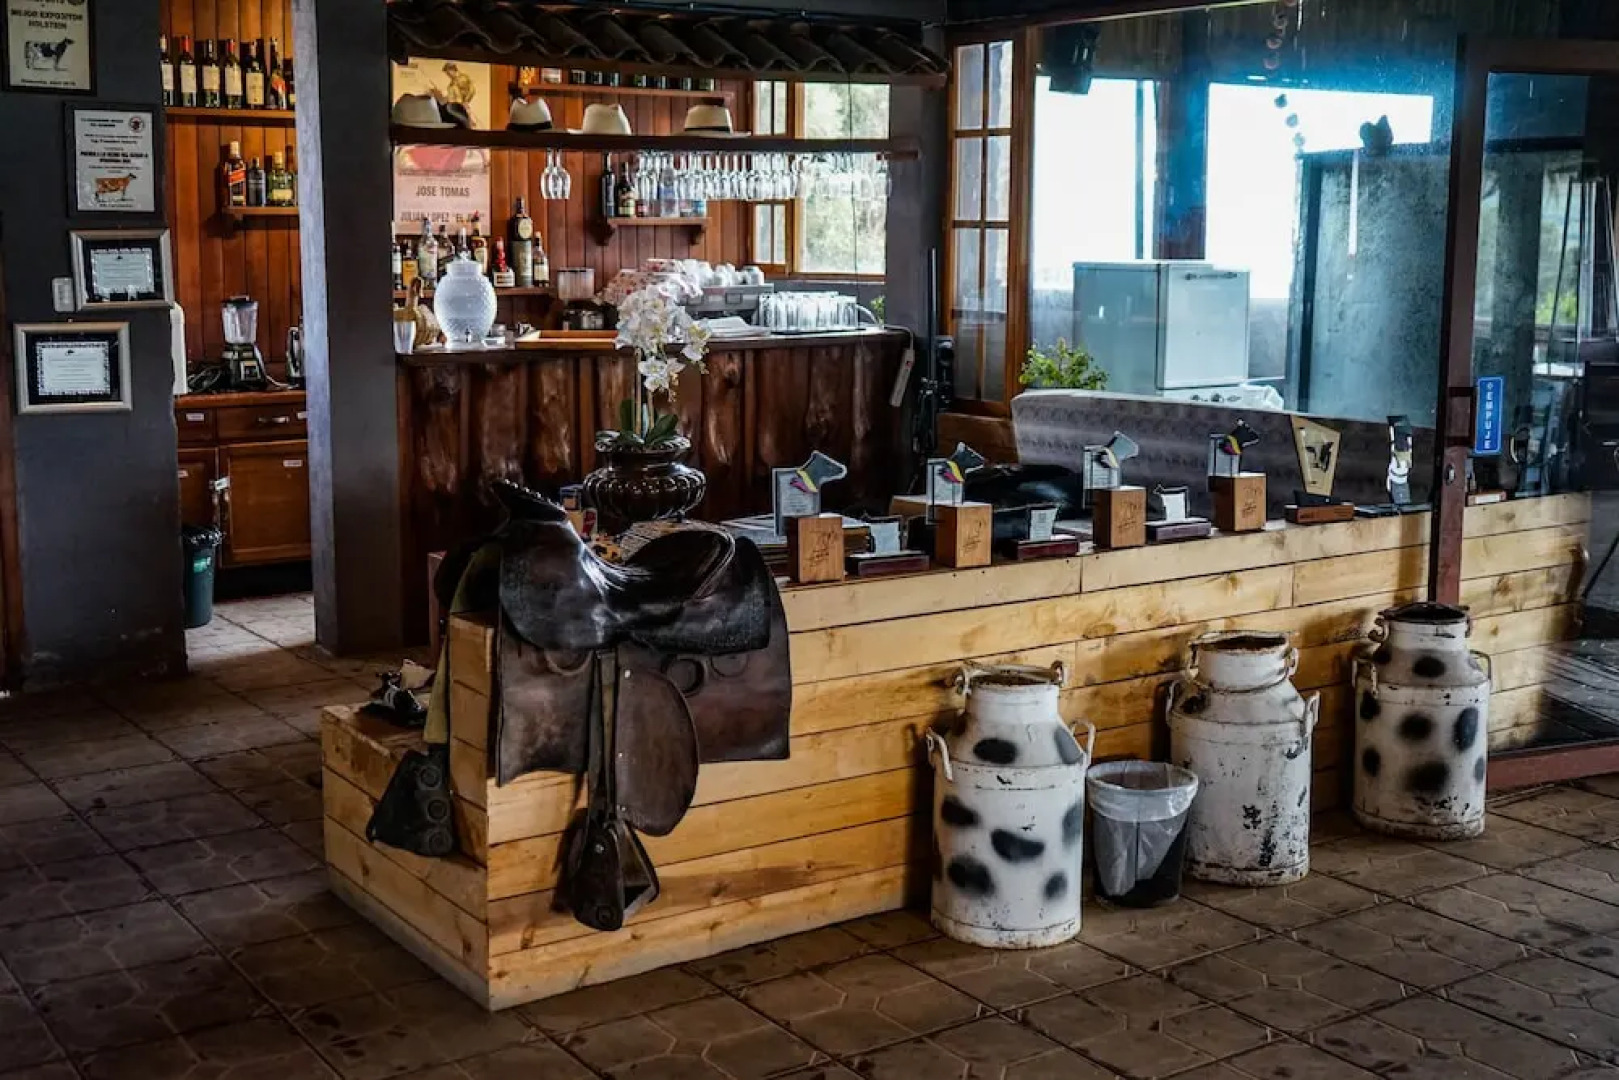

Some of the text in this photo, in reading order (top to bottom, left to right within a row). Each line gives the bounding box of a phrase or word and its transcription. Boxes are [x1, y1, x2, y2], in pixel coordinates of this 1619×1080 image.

[416, 186, 470, 198] JOSE TOMAS
[1484, 391, 1494, 449] EMPUJE
